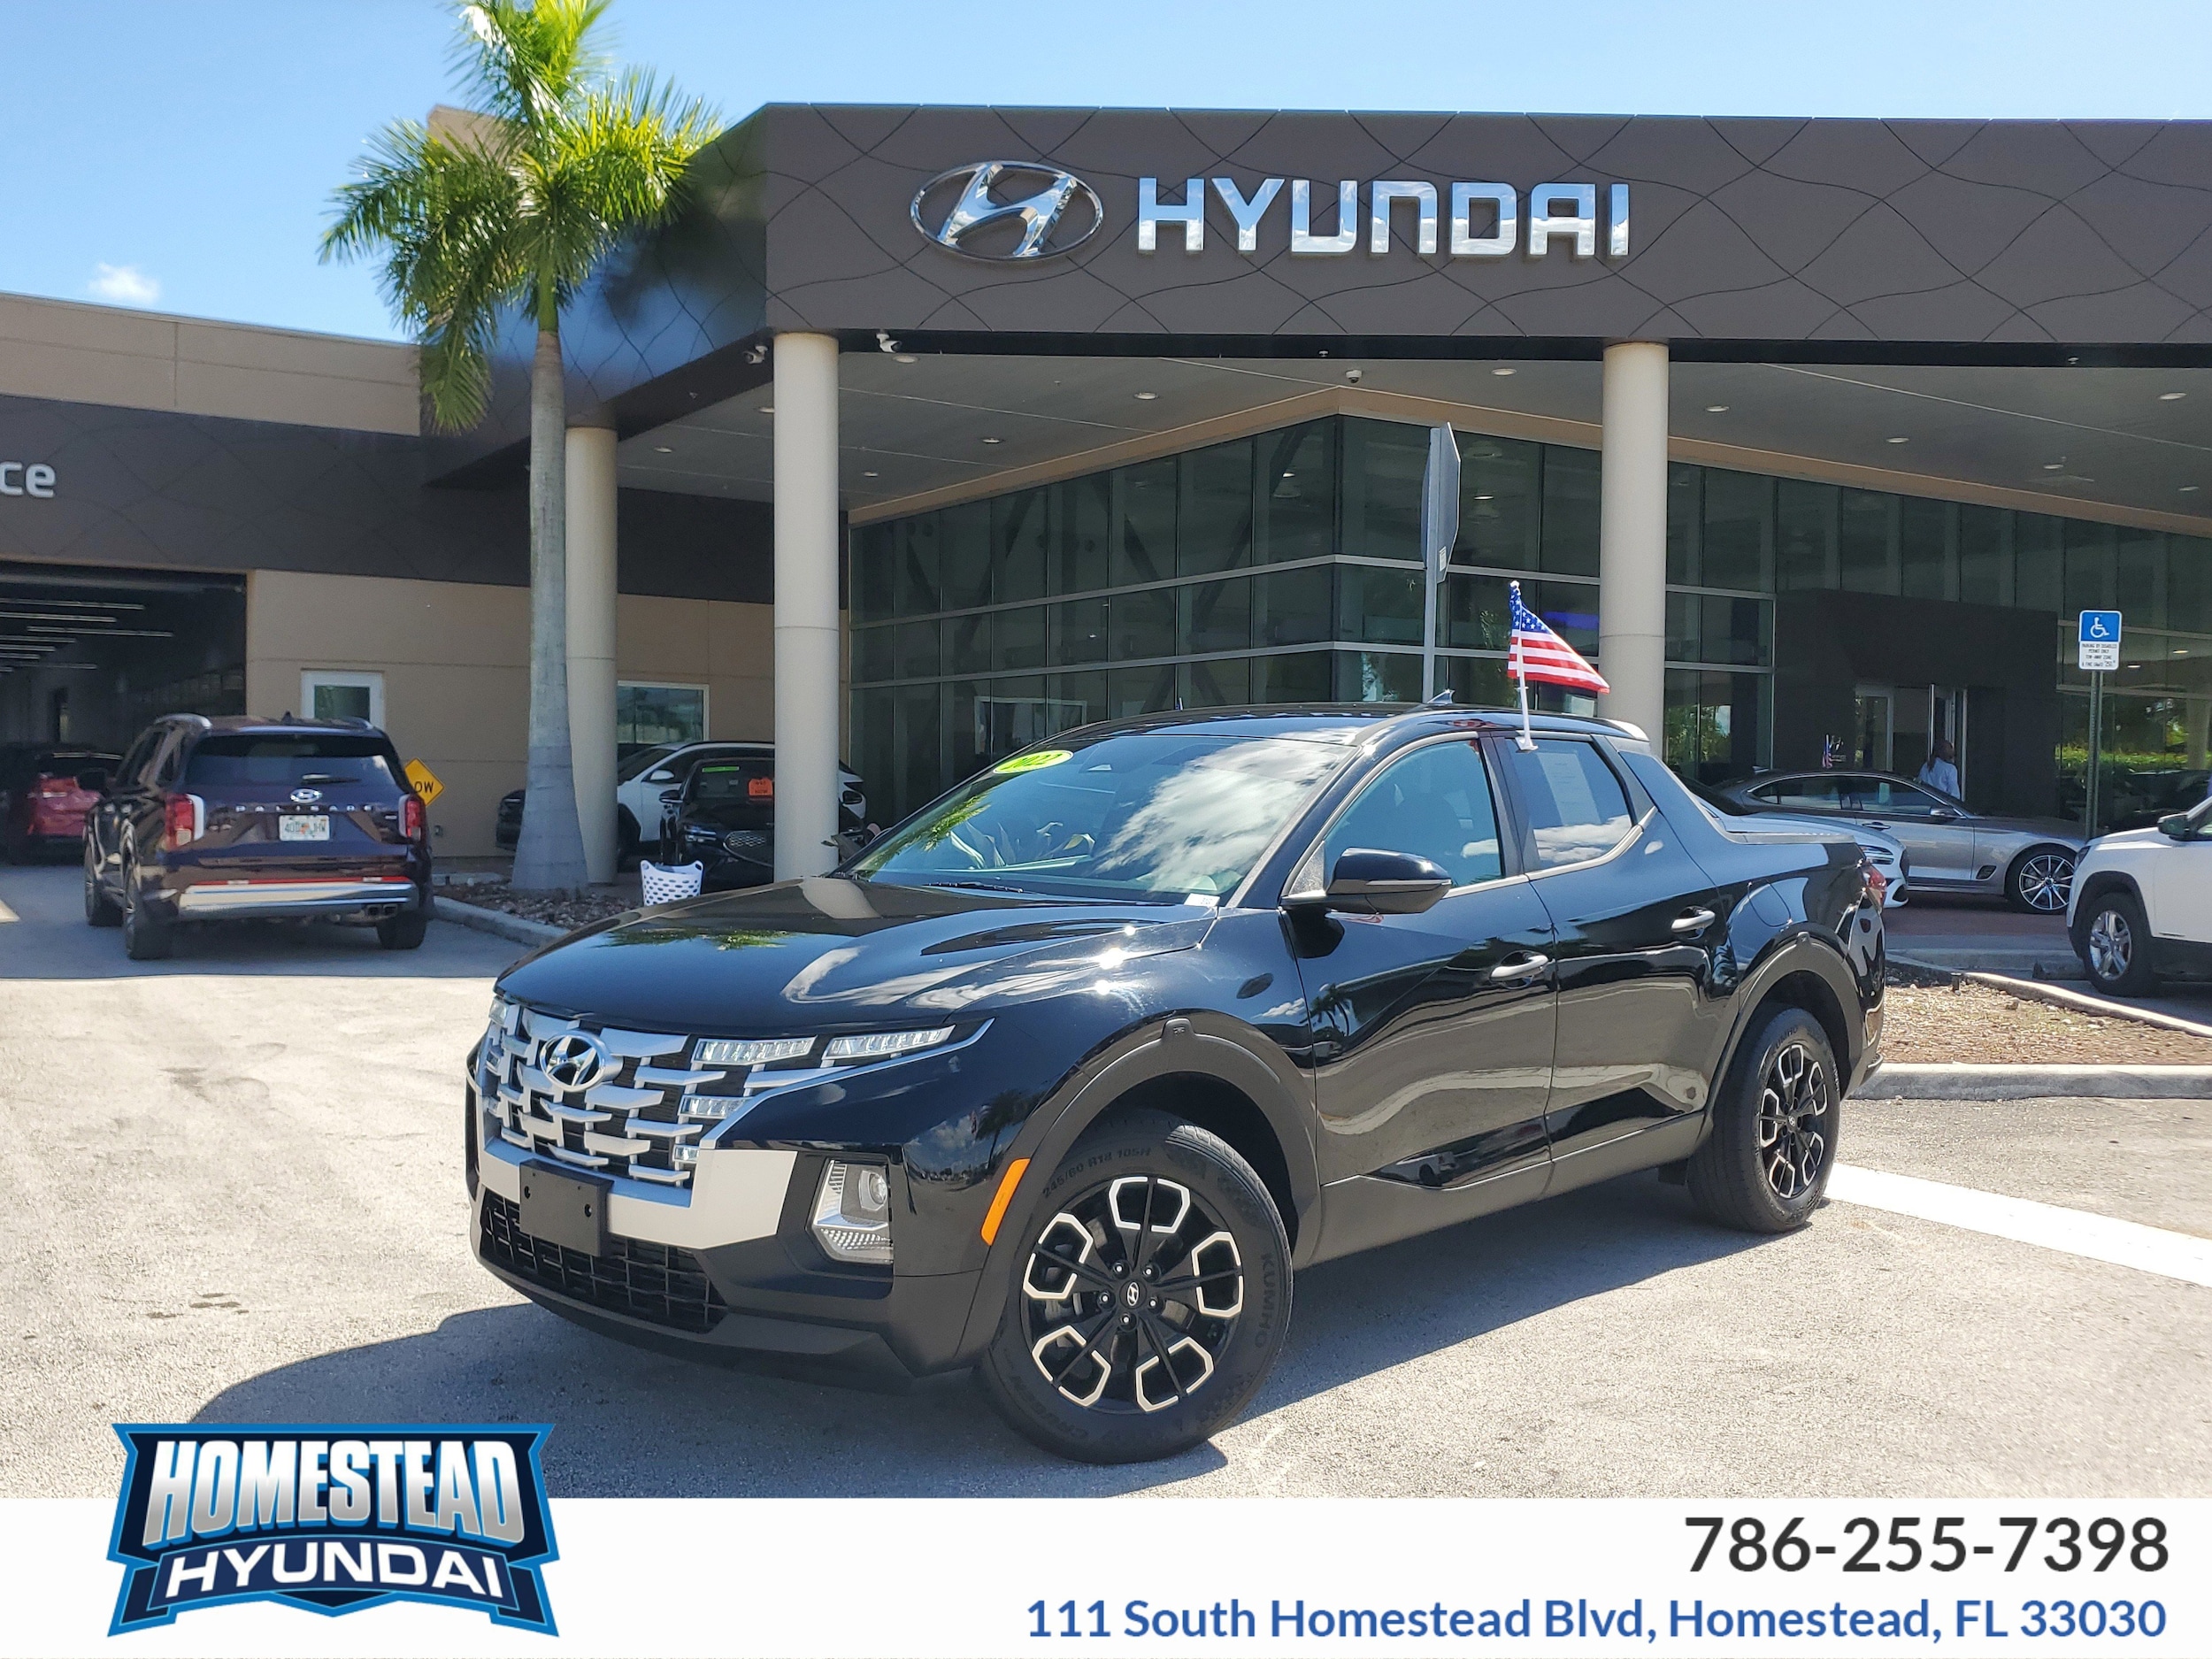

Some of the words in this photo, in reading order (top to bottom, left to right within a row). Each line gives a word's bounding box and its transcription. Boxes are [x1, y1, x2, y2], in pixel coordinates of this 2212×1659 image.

[1138, 177, 1629, 257] HYUNDAI
[1001, 753, 1064, 771] 2022
[1042, 1163, 1085, 1198] 245/60
[1087, 1151, 1112, 1168] R18
[1255, 1253, 1275, 1348] KUMHO
